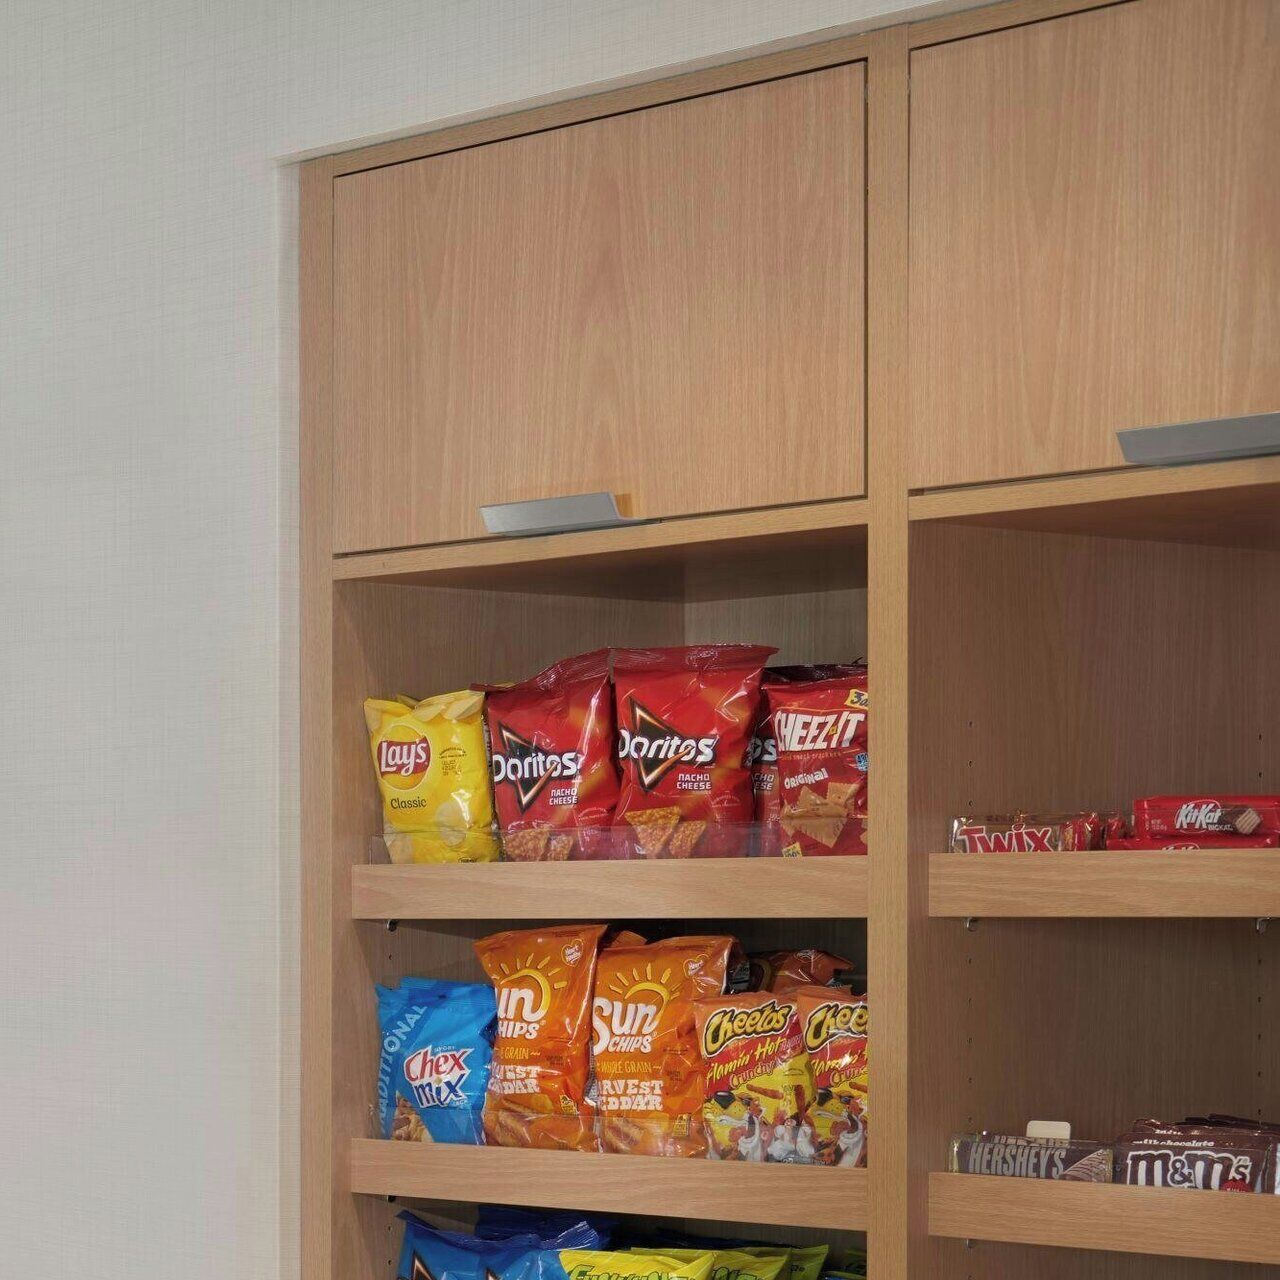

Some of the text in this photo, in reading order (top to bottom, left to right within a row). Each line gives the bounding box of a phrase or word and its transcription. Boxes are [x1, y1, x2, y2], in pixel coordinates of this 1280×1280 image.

[380, 735, 428, 776] Lay's
[676, 781, 712, 790] CHEESE
[678, 773, 710, 782] NACHO
[390, 797, 428, 810] Classic
[1175, 803, 1223, 830] KitKat
[593, 997, 658, 1056] Sun
[704, 999, 794, 1057] Cheetos
[608, 1034, 651, 1053] CHIPS
[404, 1046, 473, 1082] Chex
[600, 1061, 652, 1075] WHOLE GRAIN
[706, 1037, 782, 1085] Flamin' Hot
[968, 1142, 1068, 1179] HERSHEY'S
